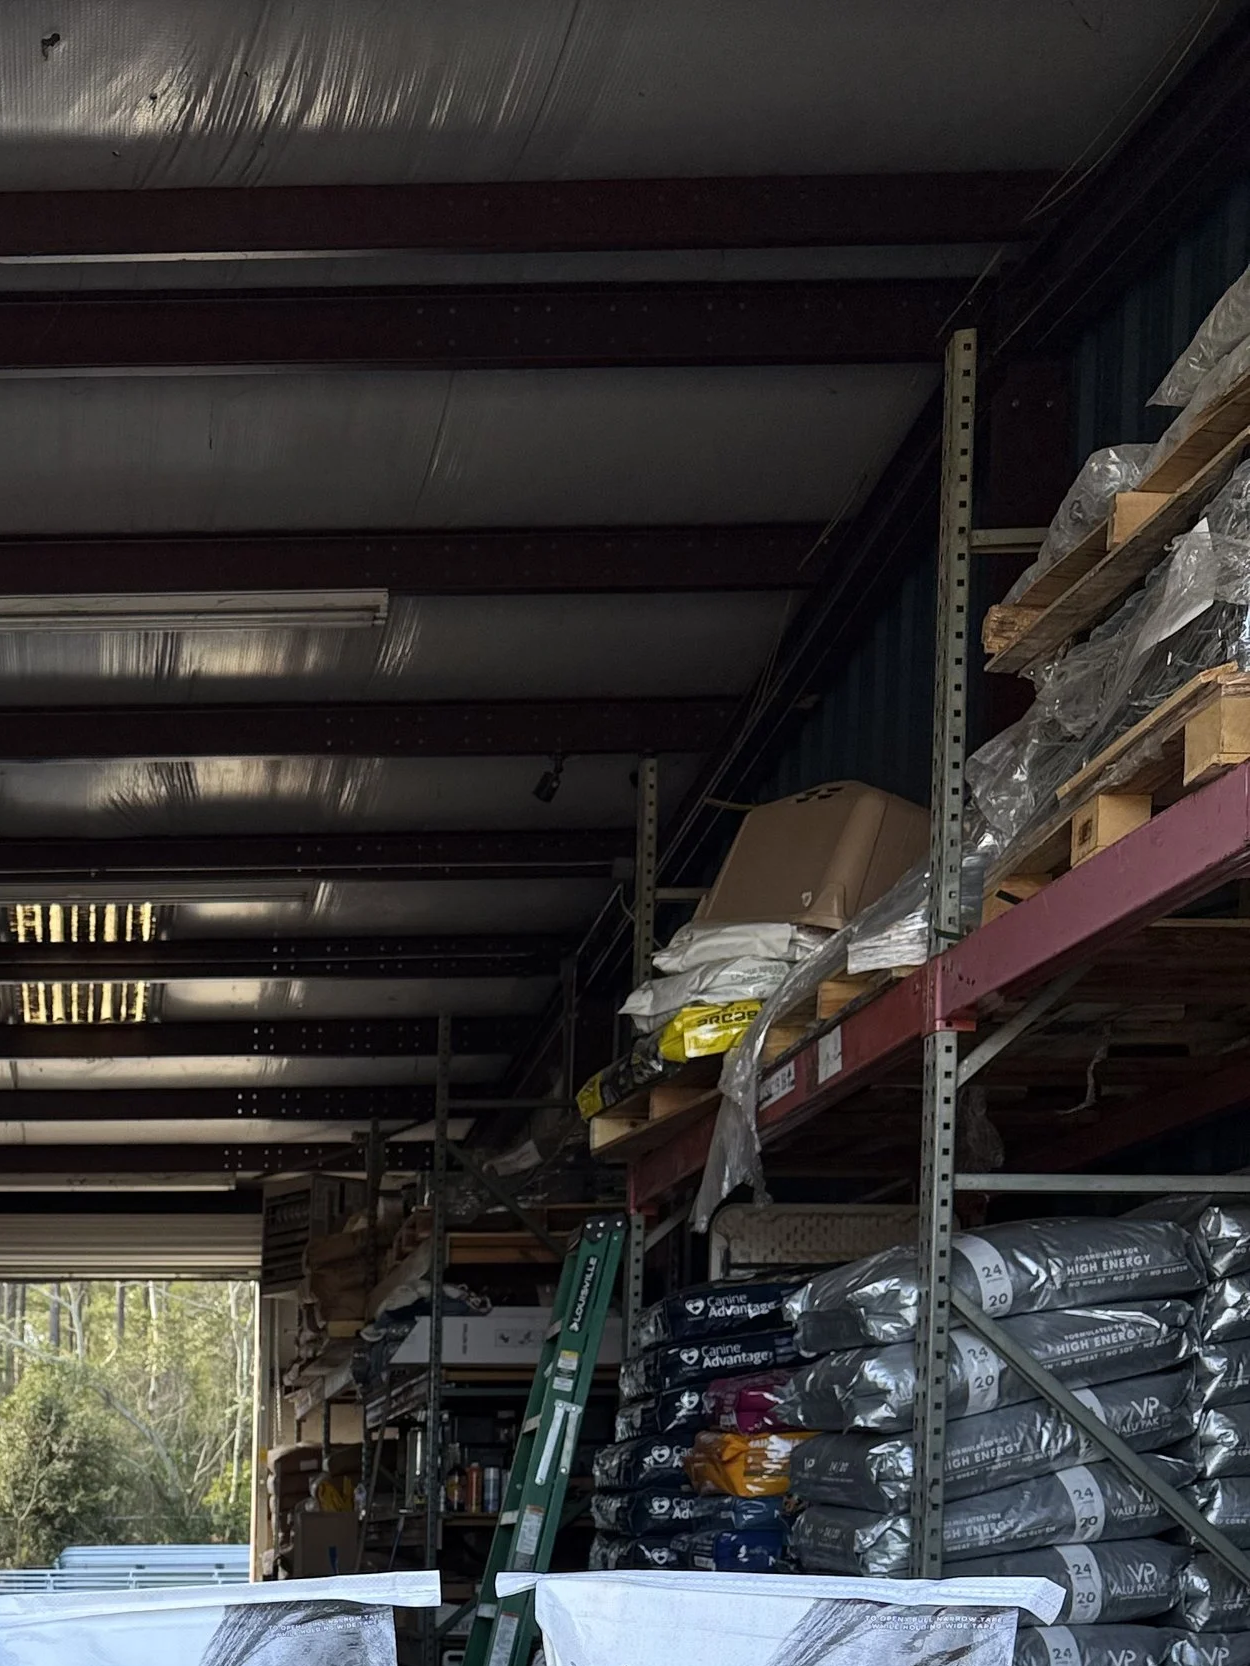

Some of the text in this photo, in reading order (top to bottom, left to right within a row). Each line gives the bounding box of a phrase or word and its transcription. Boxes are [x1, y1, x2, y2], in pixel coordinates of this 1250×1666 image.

[982, 1264, 1003, 1279] 24
[1066, 1254, 1151, 1276] HIGH ENERGY
[572, 1257, 598, 1323] LOUISVILLE
[707, 1293, 747, 1307] Canine
[989, 1293, 1008, 1307] 20
[708, 1301, 775, 1319] Advantage
[1057, 1327, 1144, 1355] HIGH ENERGY
[701, 1343, 741, 1356] Canine
[967, 1347, 988, 1360] 24
[703, 1350, 769, 1368] Advantage
[974, 1375, 995, 1389] 20
[1131, 1397, 1159, 1419] VP
[1139, 1417, 1159, 1429] PAK
[975, 1442, 1022, 1463] ENERGY
[1073, 1487, 1094, 1500] 24
[1079, 1516, 1098, 1529] 20
[1072, 1564, 1091, 1576] 24
[1127, 1564, 1156, 1585] VP
[1109, 1583, 1156, 1596] VALU PAK
[1076, 1591, 1096, 1604] 20
[1053, 1647, 1073, 1660] 24
[1201, 1647, 1229, 1666] VP
